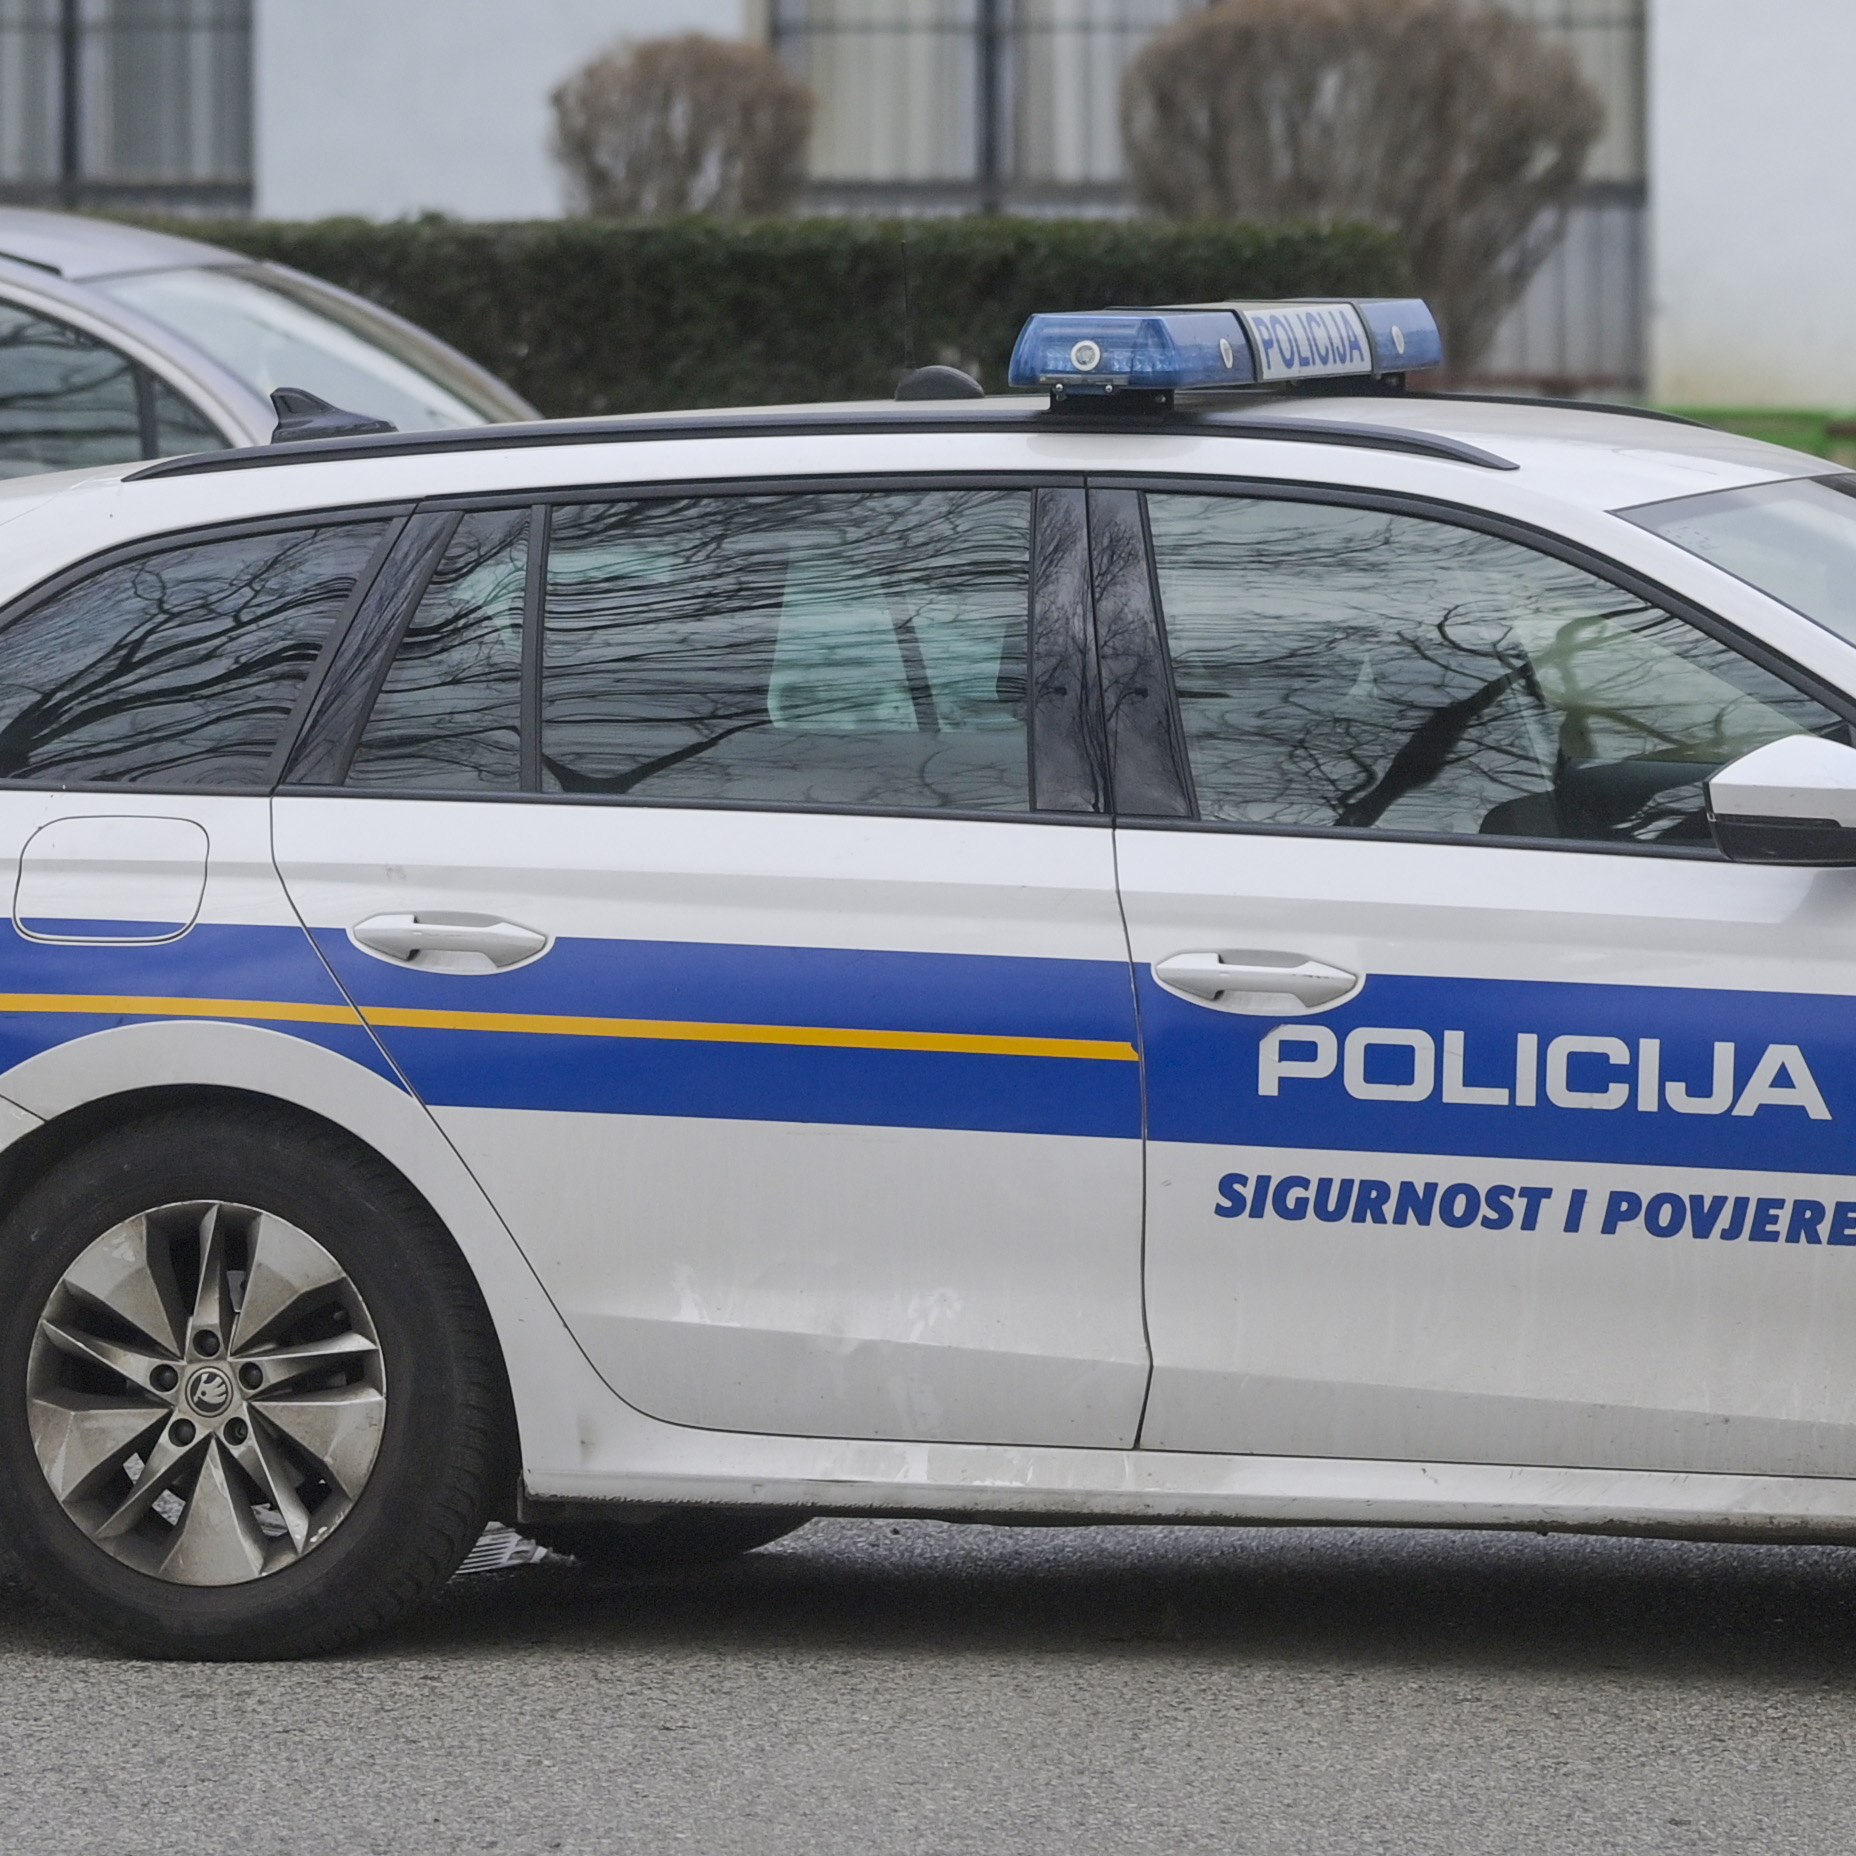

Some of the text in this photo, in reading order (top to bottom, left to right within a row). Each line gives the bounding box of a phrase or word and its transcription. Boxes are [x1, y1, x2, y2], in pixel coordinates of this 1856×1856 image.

[1252, 310, 1364, 371] POLICIJA
[1257, 1023, 1833, 1120] POLICIJA
[1213, 1172, 1554, 1232] SIGURNOST
[1564, 1188, 1588, 1234] I
